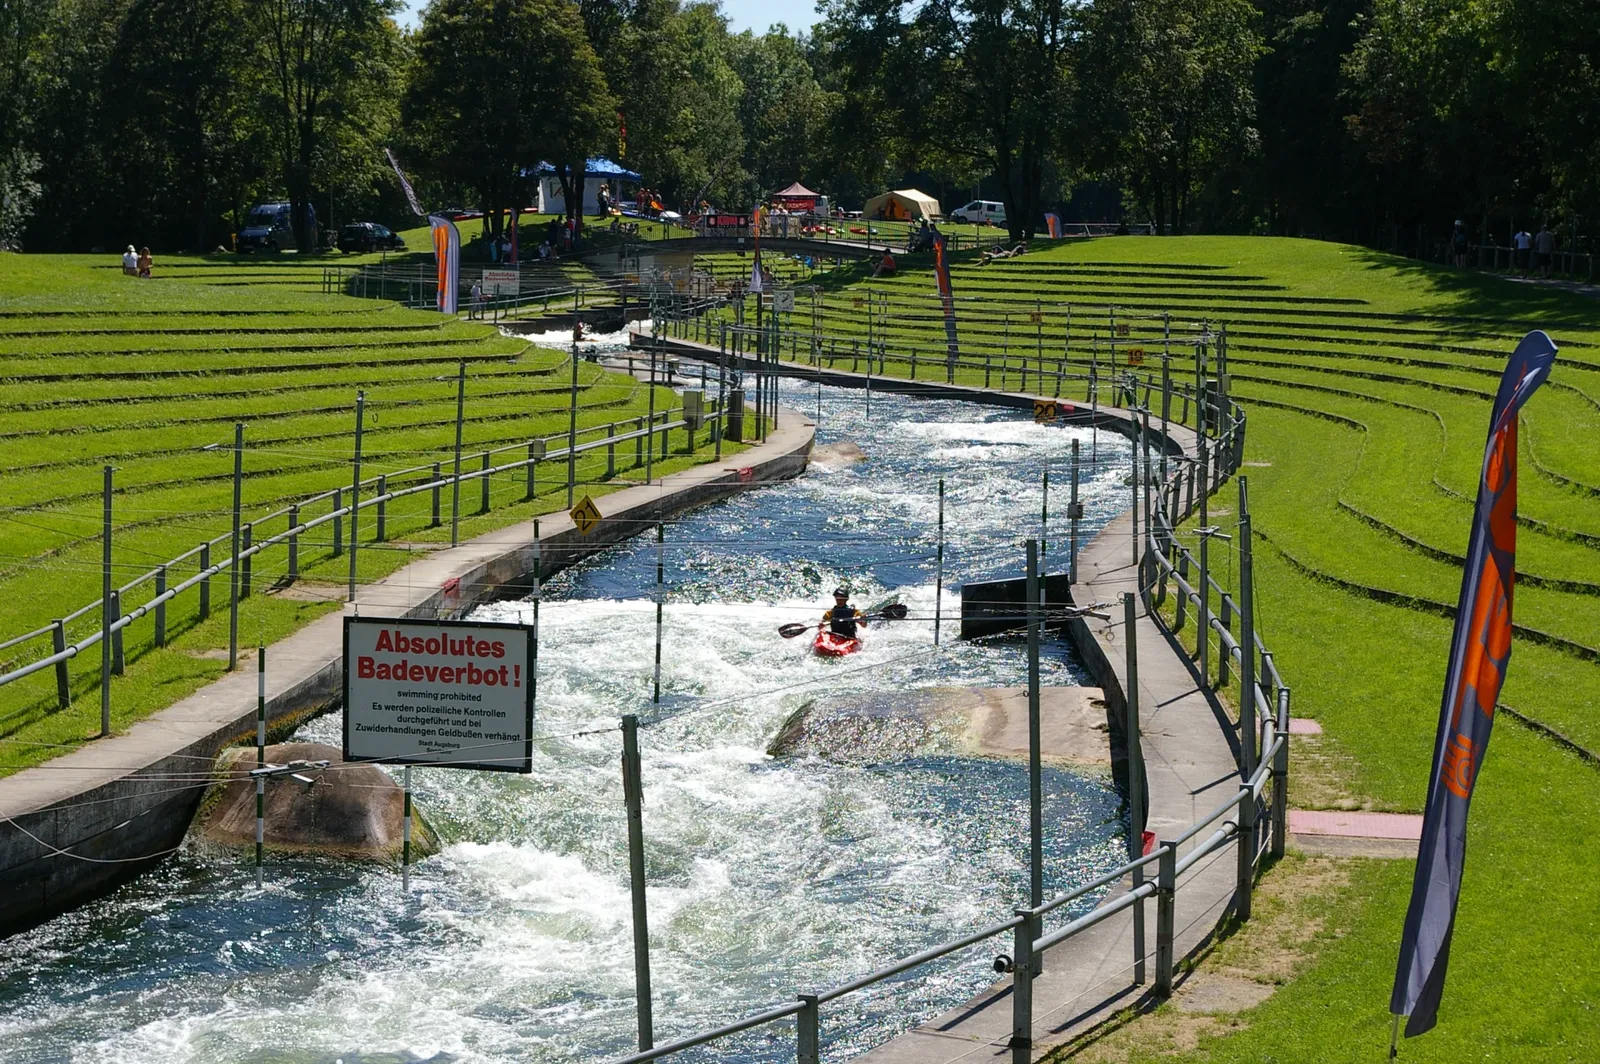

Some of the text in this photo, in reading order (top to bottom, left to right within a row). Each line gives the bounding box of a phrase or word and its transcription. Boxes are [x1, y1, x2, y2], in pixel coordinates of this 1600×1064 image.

[1128, 350, 1143, 362] 19
[1034, 403, 1057, 419] 20
[575, 501, 598, 531] 21
[375, 629, 505, 658] Absolutes
[397, 690, 482, 702] swimming prohibited
[372, 702, 507, 718] Es werden polizeiliche Kontrollen
[397, 715, 482, 728] durchgeführt und bei
[355, 723, 437, 736] Zuwiderhandlungen
[438, 728, 483, 739] Geldbußen
[418, 739, 461, 749] Stadt Augsburg
